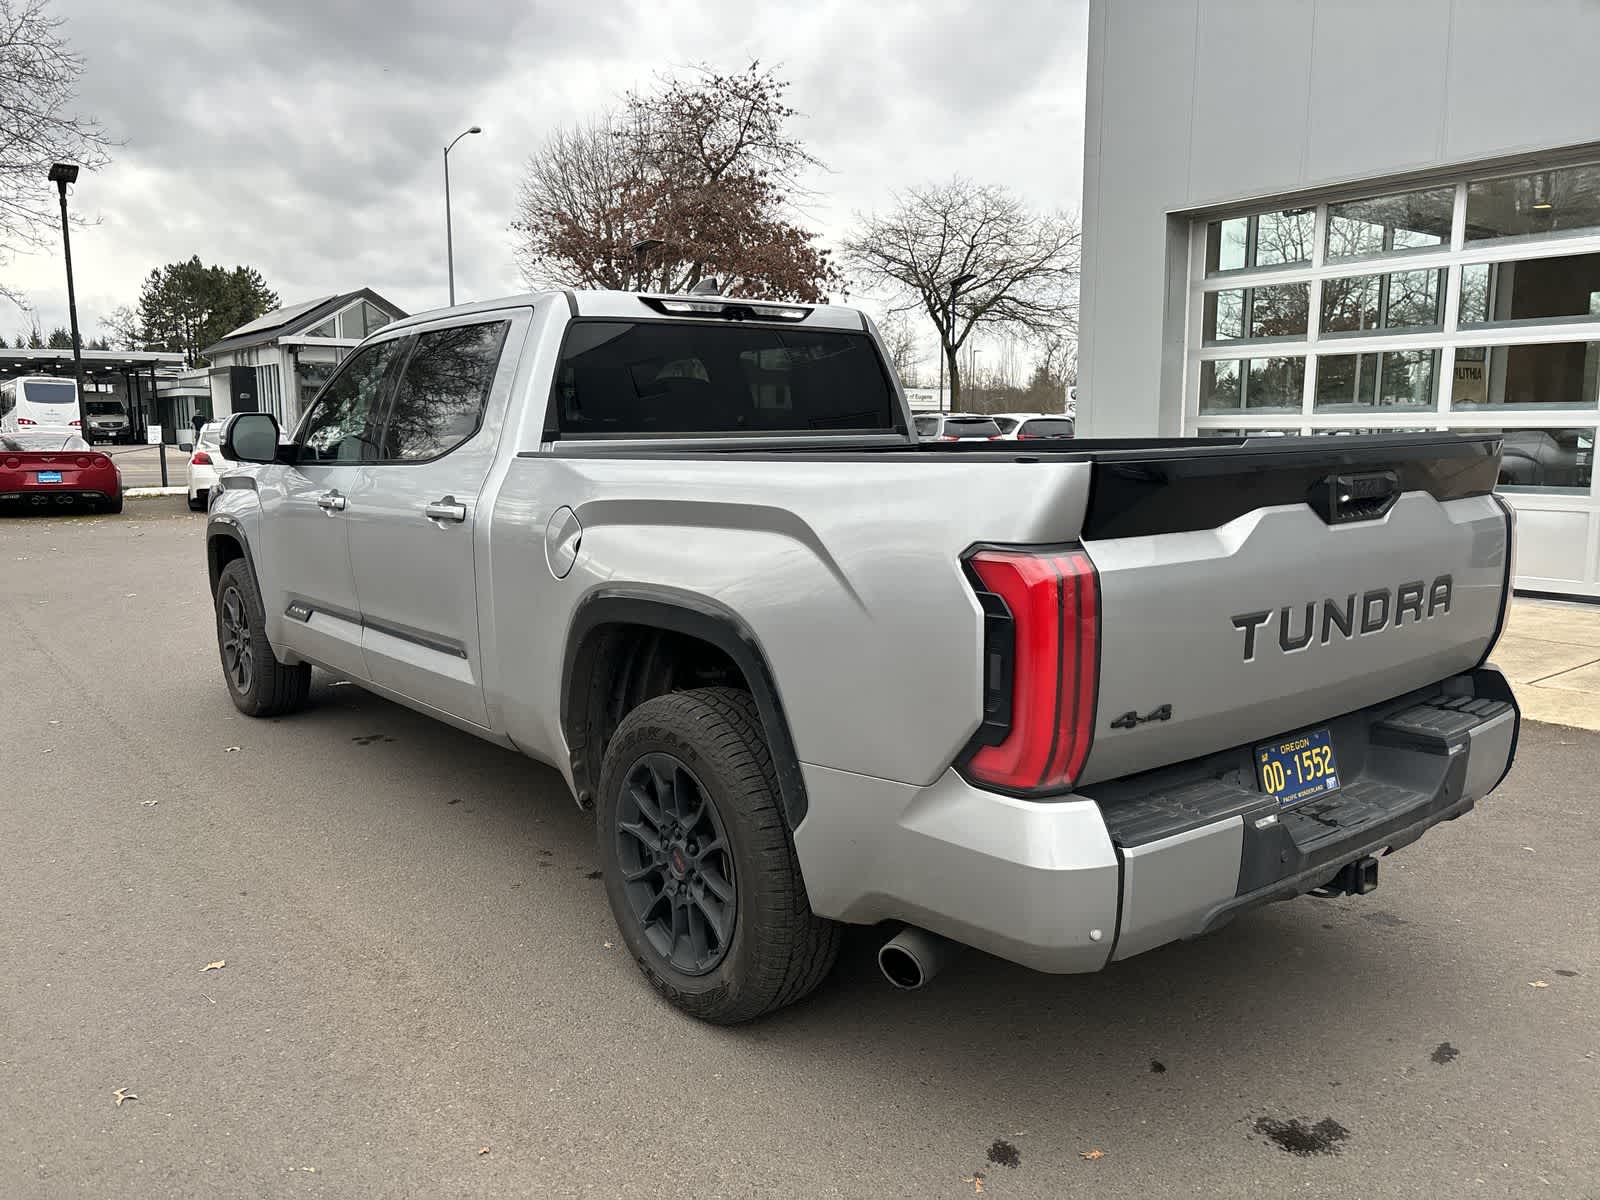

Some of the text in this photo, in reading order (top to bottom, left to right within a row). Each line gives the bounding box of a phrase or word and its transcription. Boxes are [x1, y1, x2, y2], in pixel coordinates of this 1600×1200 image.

[1230, 573, 1454, 664] TUNDRA
[1280, 738, 1310, 754] OREGON
[1282, 794, 1298, 802] PACIFIC
